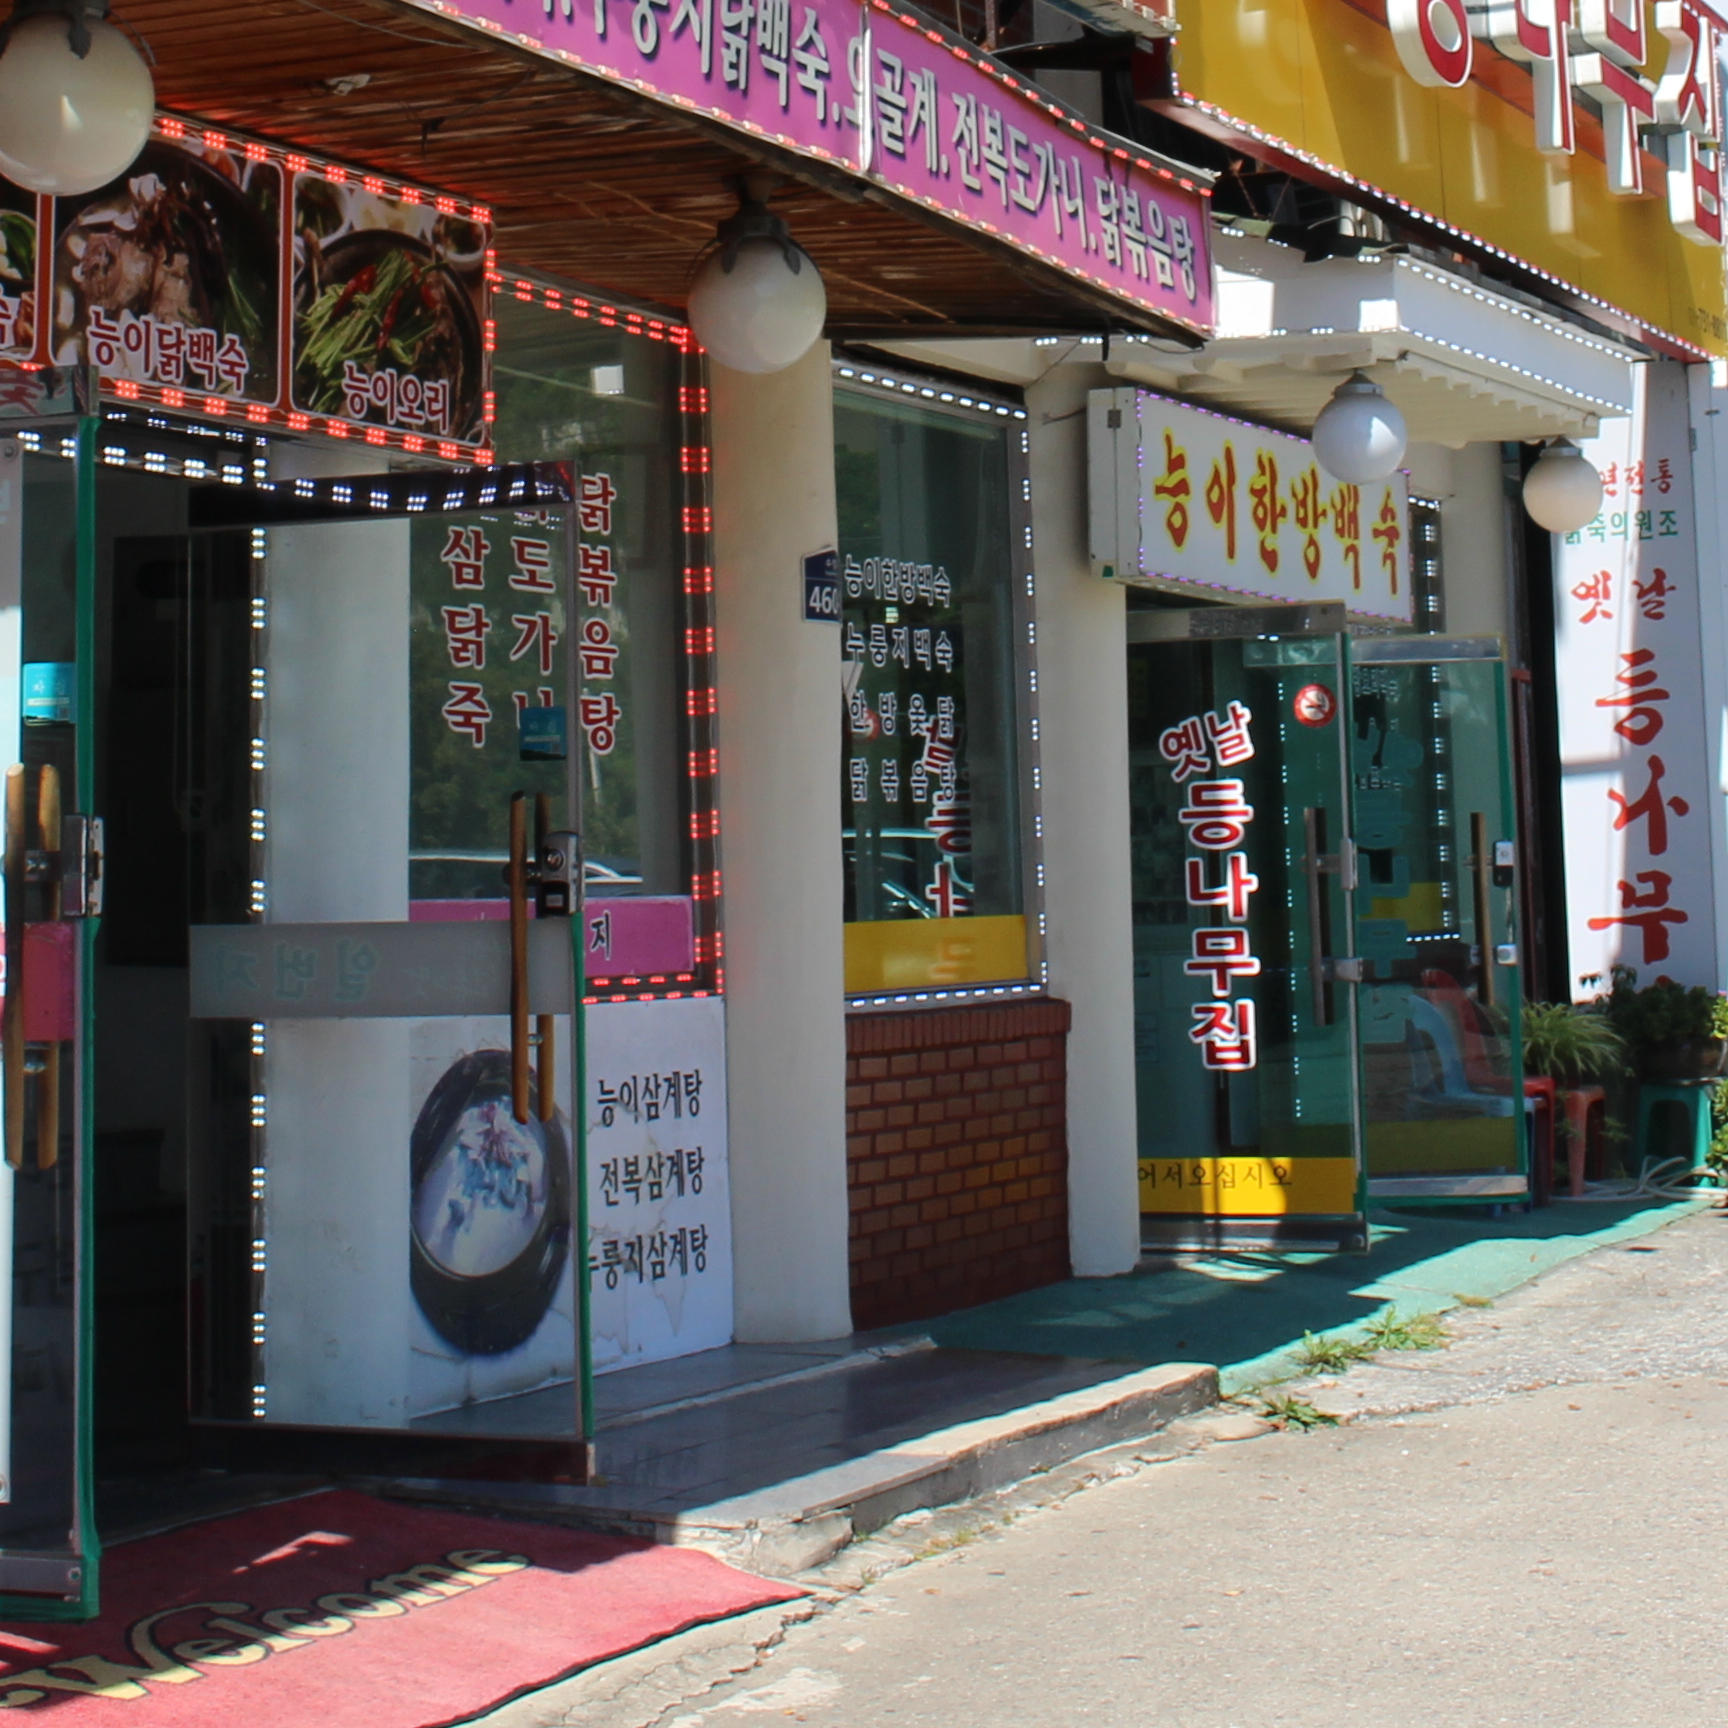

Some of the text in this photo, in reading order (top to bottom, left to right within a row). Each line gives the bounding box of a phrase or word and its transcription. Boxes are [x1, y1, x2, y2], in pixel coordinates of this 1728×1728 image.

[86, 303, 251, 396] 능이닭백숙
[340, 361, 451, 434] 능이오리
[1152, 427, 1403, 597] 능이한방백숙
[578, 472, 622, 756] 닭볶음탕
[844, 553, 953, 609] 능이한방백숙
[1570, 567, 1678, 625] 옛날
[845, 621, 955, 674] 누룽지백숙
[1158, 699, 1256, 783] 옛날
[1586, 646, 1691, 984] 등나무
[1177, 776, 1262, 1072] 등나무집
[595, 1068, 704, 1129] 능이삼계탕
[599, 1146, 705, 1207] 전복삼계탕
[1137, 1162, 1294, 1190] 어서오십시오
